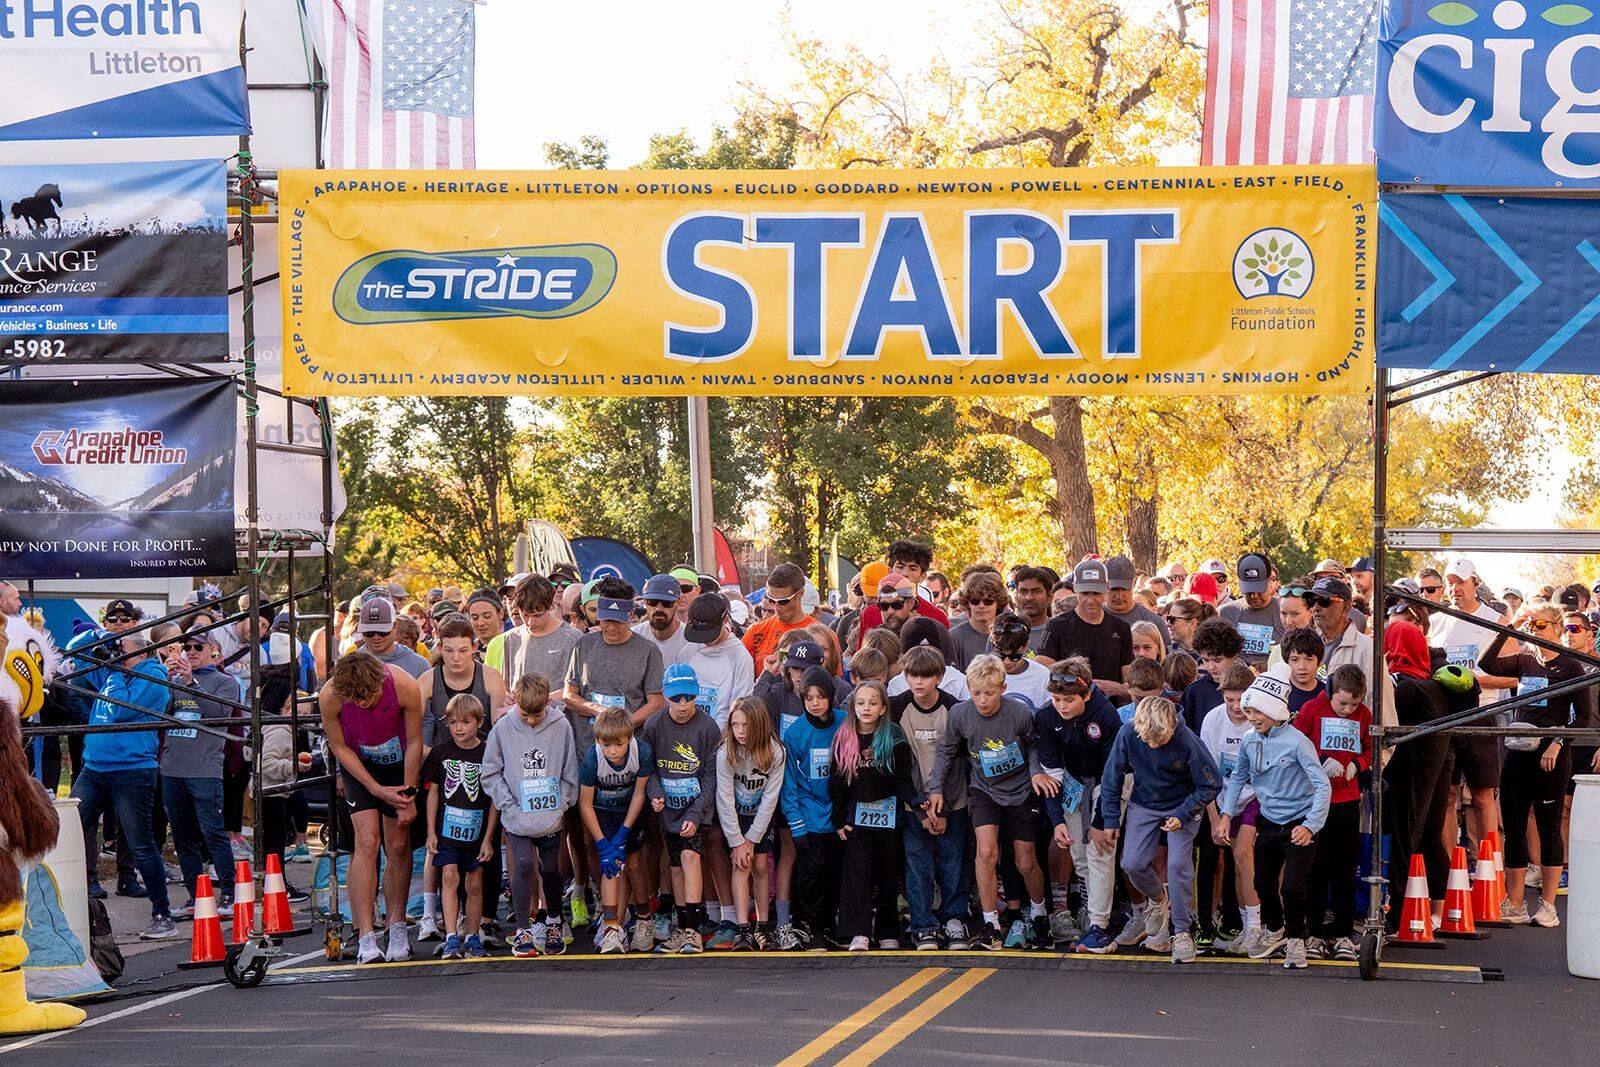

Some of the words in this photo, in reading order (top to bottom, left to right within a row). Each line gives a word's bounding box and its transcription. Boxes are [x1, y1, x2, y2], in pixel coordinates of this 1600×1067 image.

[89, 51, 202, 75] Littleton
[313, 181, 406, 198] ARAPAHOE
[424, 182, 509, 193] HERITAGE
[527, 183, 618, 194] LITTLETON
[636, 183, 713, 195] OPTIONS
[735, 183, 797, 195] EUCLID
[815, 183, 900, 194] GODDARD
[917, 182, 992, 193] NEWTON
[1011, 181, 1082, 192] POWELL
[1104, 178, 1215, 191] CENTENNIAL
[1234, 177, 1276, 188] EAST
[1294, 175, 1344, 192] FIELD
[290, 207, 306, 280] VILLAGE
[1352, 203, 1366, 291] FRANKLIN
[36, 278, 97, 294] Services
[406, 268, 577, 300] STRIDE
[661, 208, 1180, 361] START
[291, 285, 303, 316] THE
[1231, 307, 1263, 316] Littleton
[1264, 307, 1286, 315] Public
[1287, 306, 1316, 315] Schools
[46, 320, 88, 331] Business
[98, 319, 118, 331] Life
[1231, 316, 1316, 330] Foundation
[1316, 308, 1366, 383] HIGHLAND
[292, 333, 320, 375] PREP
[322, 372, 413, 384] LITTLETON
[430, 373, 510, 385] ACADEMY
[516, 373, 605, 385] LITTLETON
[621, 374, 685, 385] WILDER
[702, 374, 756, 385] TWAIN
[773, 374, 865, 385] SANDBURG
[882, 374, 953, 385] RUNYON
[970, 373, 1049, 385] PEABODY
[1066, 373, 1128, 384] MOODY
[1146, 372, 1205, 384] LENSKI
[1222, 372, 1298, 383] HOPKINS
[63, 427, 163, 449] Arapahoe
[64, 445, 126, 465] Credit
[129, 444, 187, 465] Union
[29, 541, 60, 552] NOT
[113, 541, 141, 552] FOR
[180, 558, 207, 567] NCUA
[1262, 681, 1282, 694] USA
[1325, 735, 1355, 751] 2082
[657, 759, 689, 771] STRIDE
[989, 758, 1018, 776] 1452
[528, 795, 557, 811] 1329
[861, 811, 888, 826] 2123
[449, 825, 476, 841] 1847
